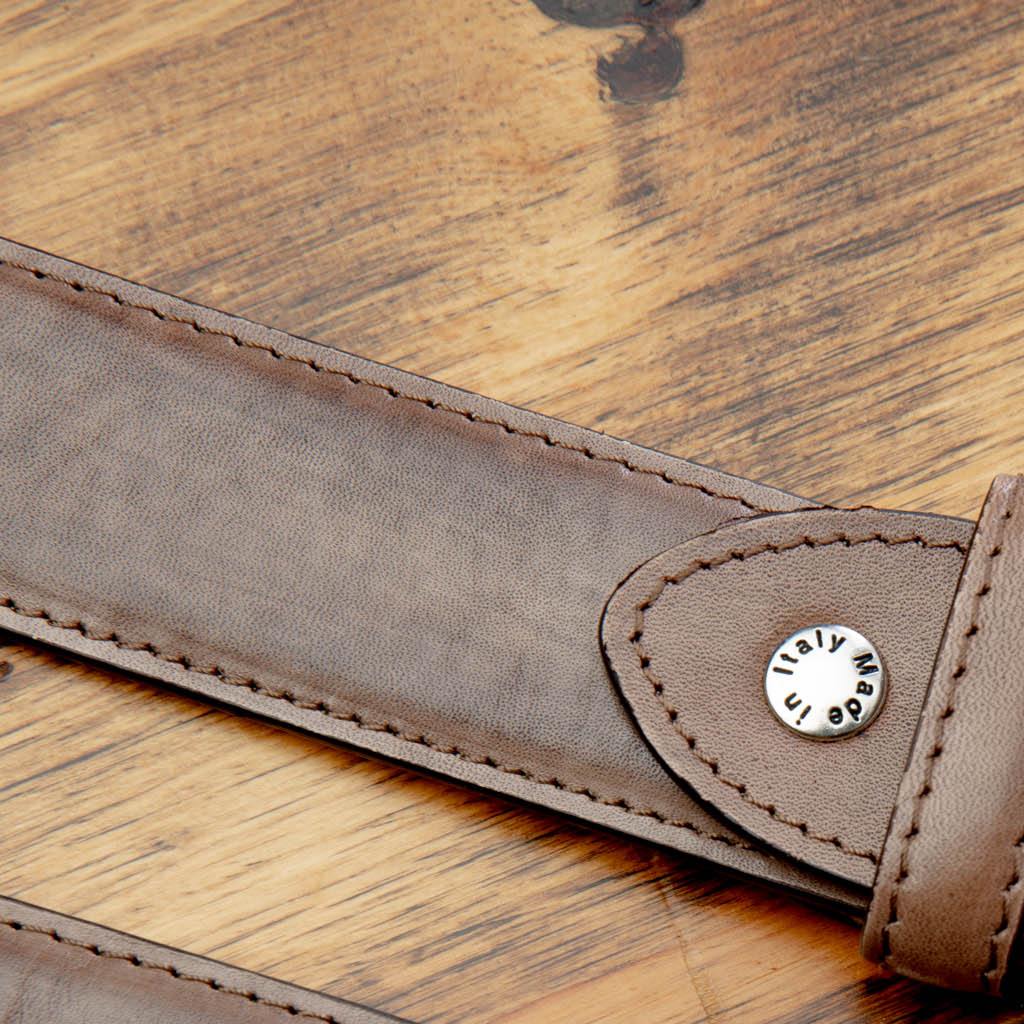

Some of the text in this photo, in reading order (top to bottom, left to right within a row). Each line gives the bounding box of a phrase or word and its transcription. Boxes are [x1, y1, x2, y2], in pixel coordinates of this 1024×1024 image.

[772, 629, 880, 726] Made in Italy
